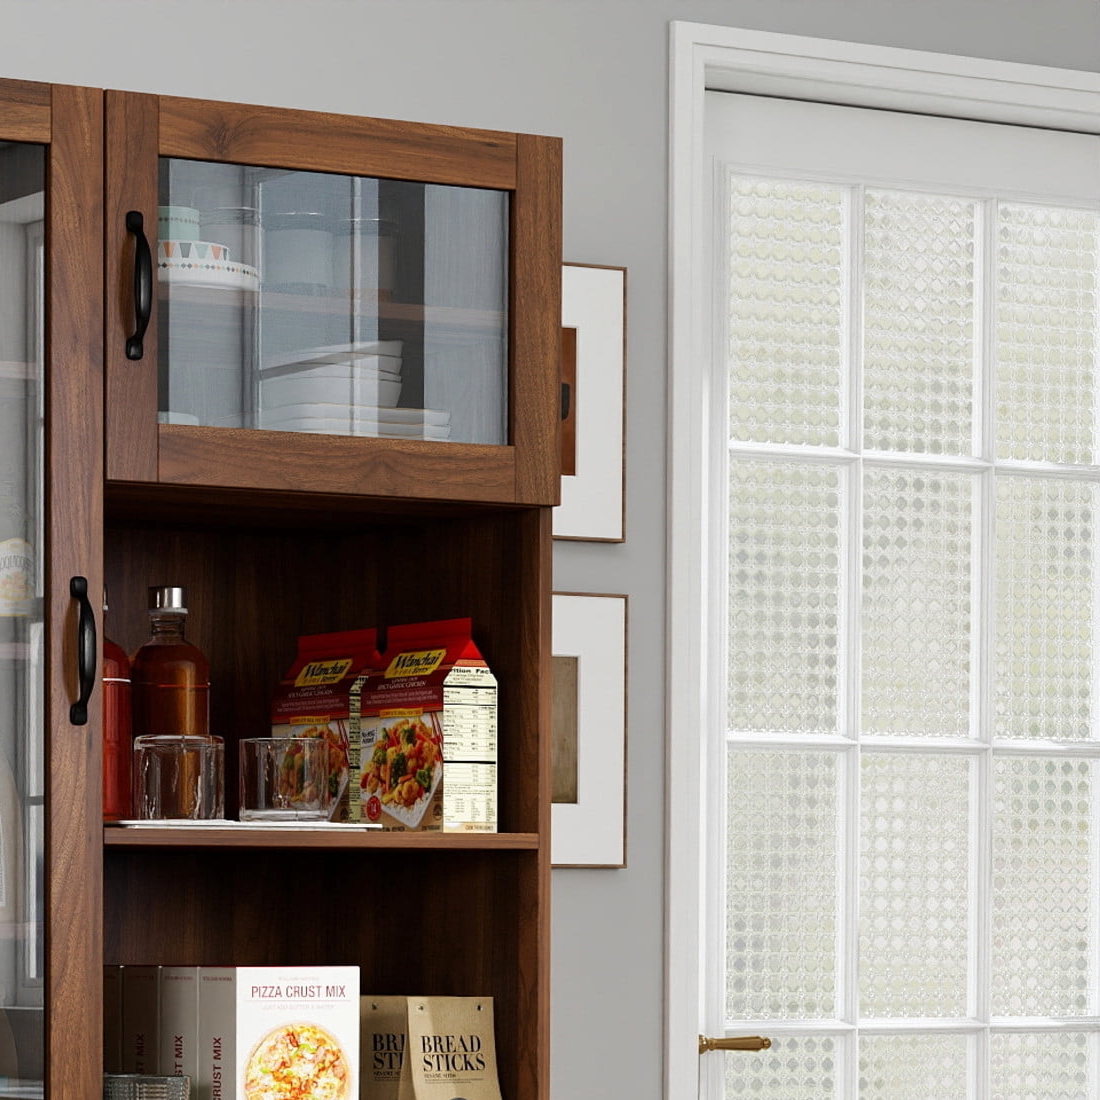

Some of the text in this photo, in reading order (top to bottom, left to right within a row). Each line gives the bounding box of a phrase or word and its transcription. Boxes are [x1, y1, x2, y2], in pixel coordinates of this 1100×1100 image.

[251, 985, 346, 998] PIZZA CRUST MIX
[175, 1036, 183, 1058] MIX
[213, 1037, 222, 1060] MIX
[420, 1035, 481, 1053] BREAD
[423, 1053, 486, 1072] STICKS
